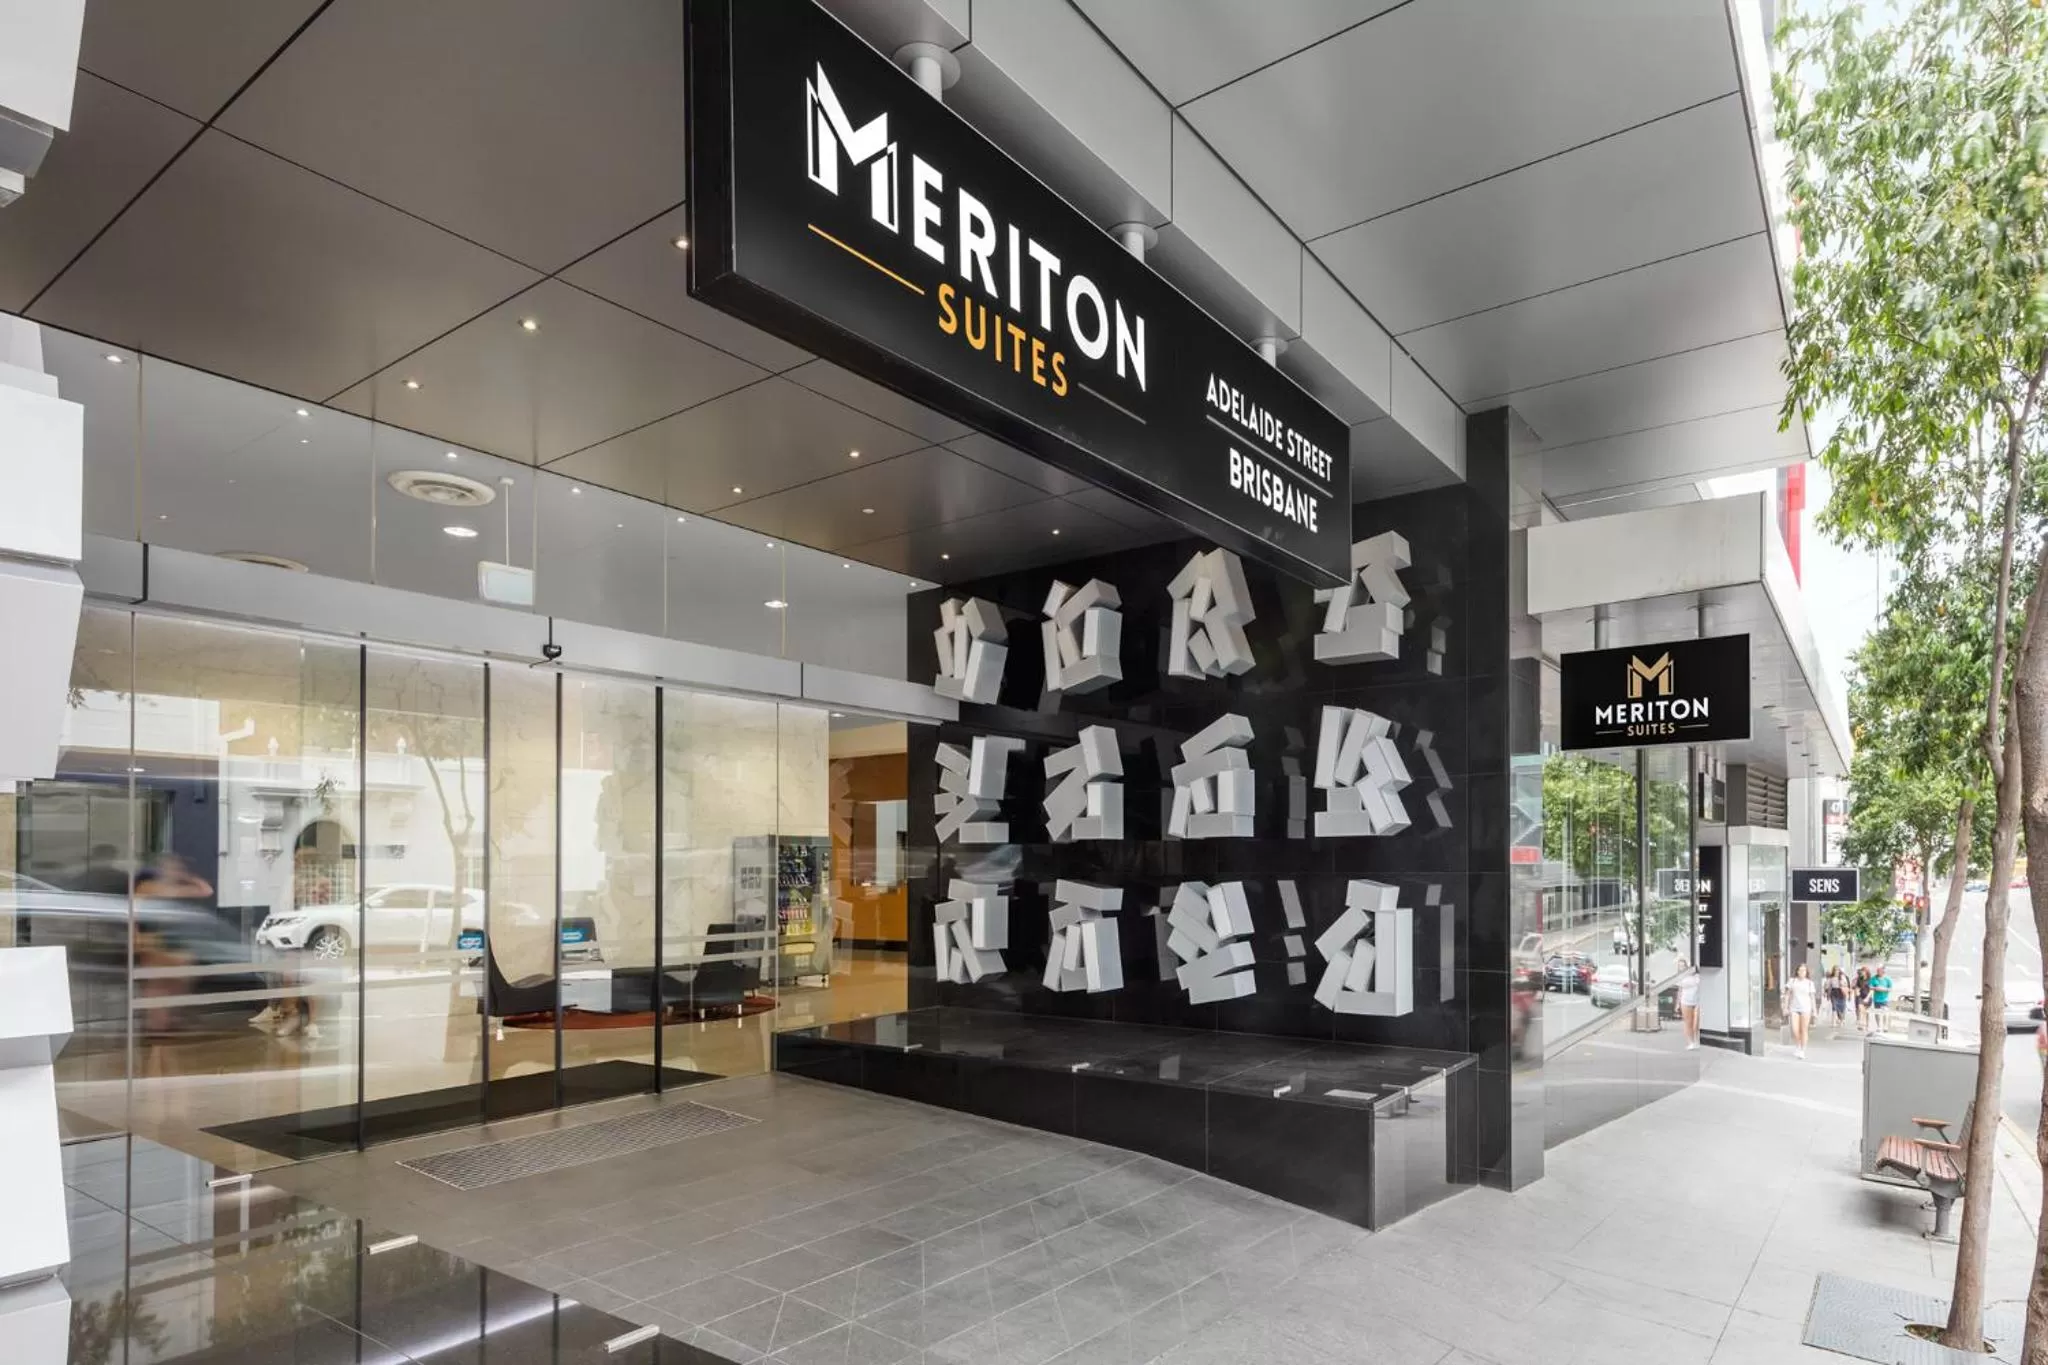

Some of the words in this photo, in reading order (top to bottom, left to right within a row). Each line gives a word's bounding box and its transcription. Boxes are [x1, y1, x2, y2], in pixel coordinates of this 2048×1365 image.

[806, 60, 1147, 393] MERITON
[938, 282, 1069, 397] SUITES
[1206, 372, 1283, 450] ADELAIDE
[1287, 428, 1333, 482] STREET
[1229, 447, 1318, 533] BRISBANE
[1595, 697, 1709, 725] MERITON
[1626, 722, 1676, 737] SUITES
[1808, 878, 1840, 894] SENS
